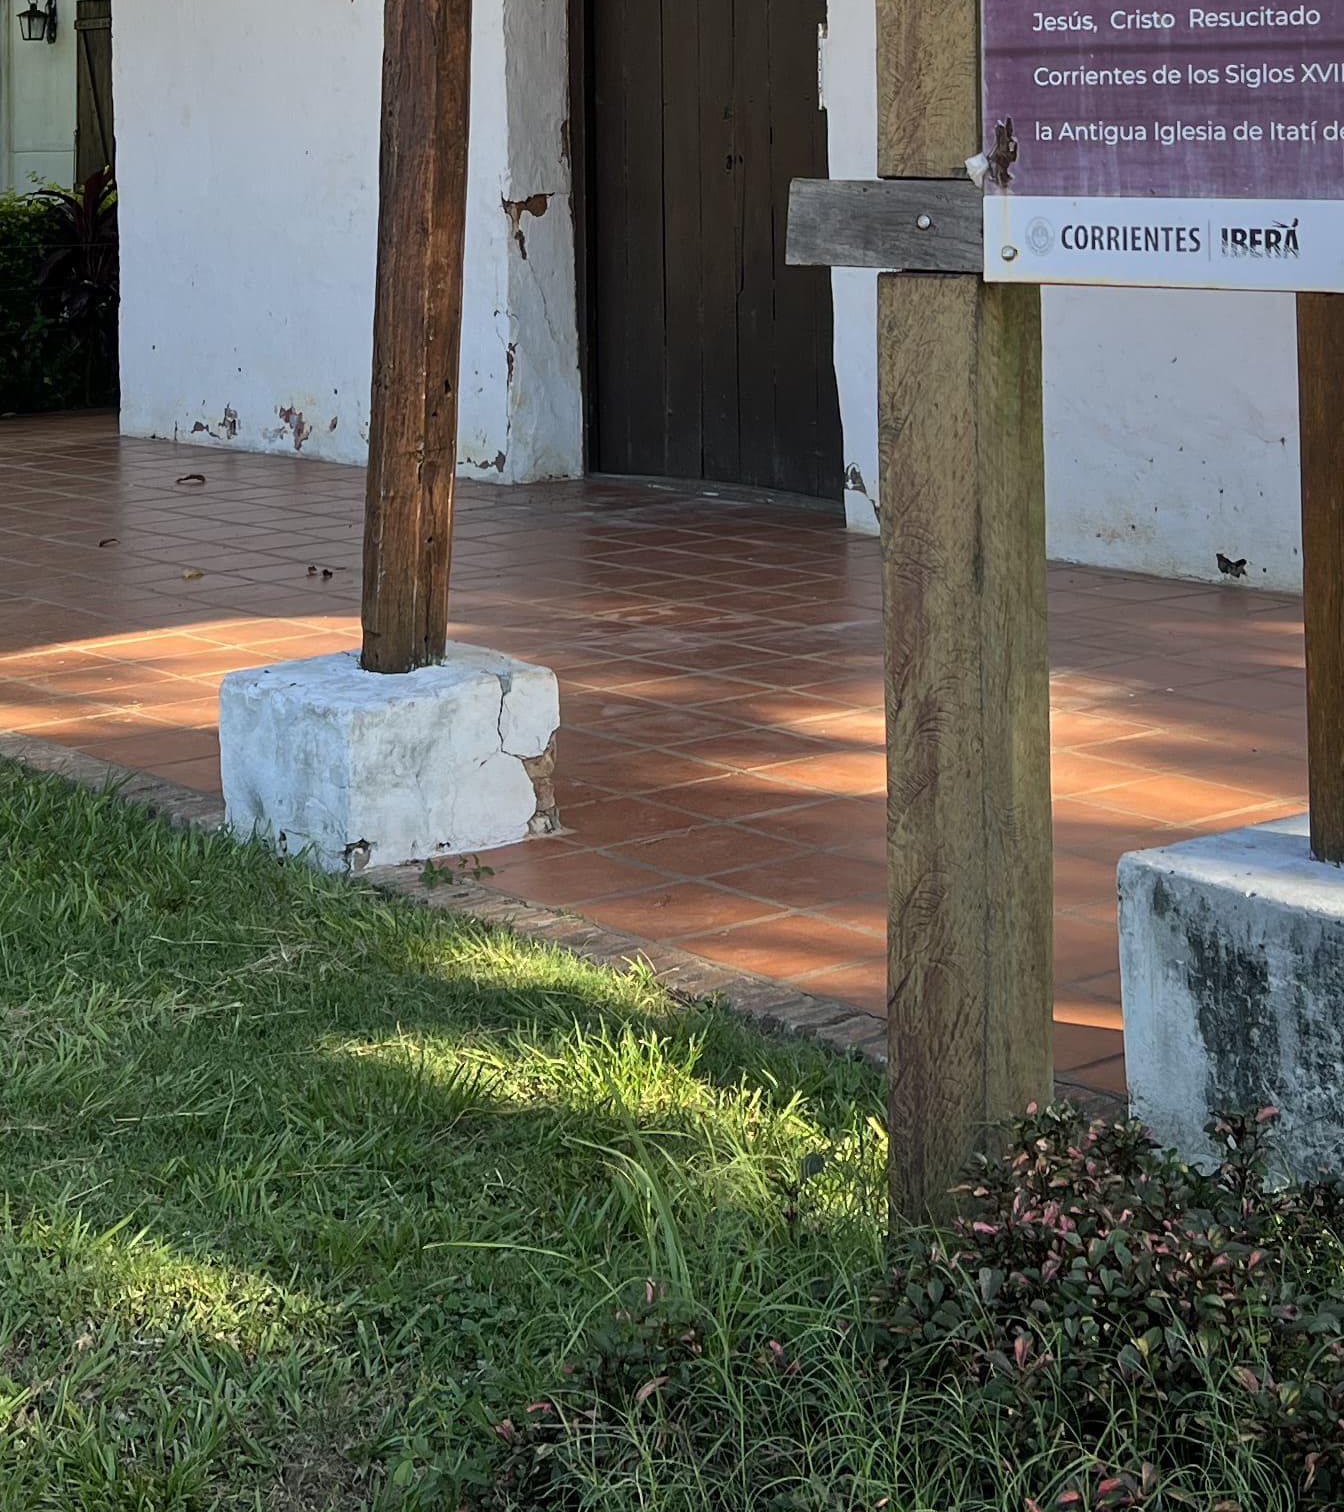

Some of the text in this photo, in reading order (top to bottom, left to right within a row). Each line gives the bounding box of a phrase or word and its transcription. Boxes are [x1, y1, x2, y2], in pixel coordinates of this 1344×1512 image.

[1033, 10, 1097, 34] Jesús,
[1111, 8, 1175, 30] Cristo
[1190, 4, 1320, 29] Resucitado
[1034, 64, 1147, 87] Corrientes
[1152, 63, 1181, 85] de
[1188, 63, 1219, 85] los
[1225, 62, 1295, 89] Siglos
[1036, 120, 1052, 141] la
[1058, 120, 1146, 146] Antigua
[1155, 120, 1226, 146] Iglesia
[1233, 120, 1263, 142] de
[1271, 120, 1317, 144] Itatí
[1061, 224, 1202, 253] CORRIENTES
